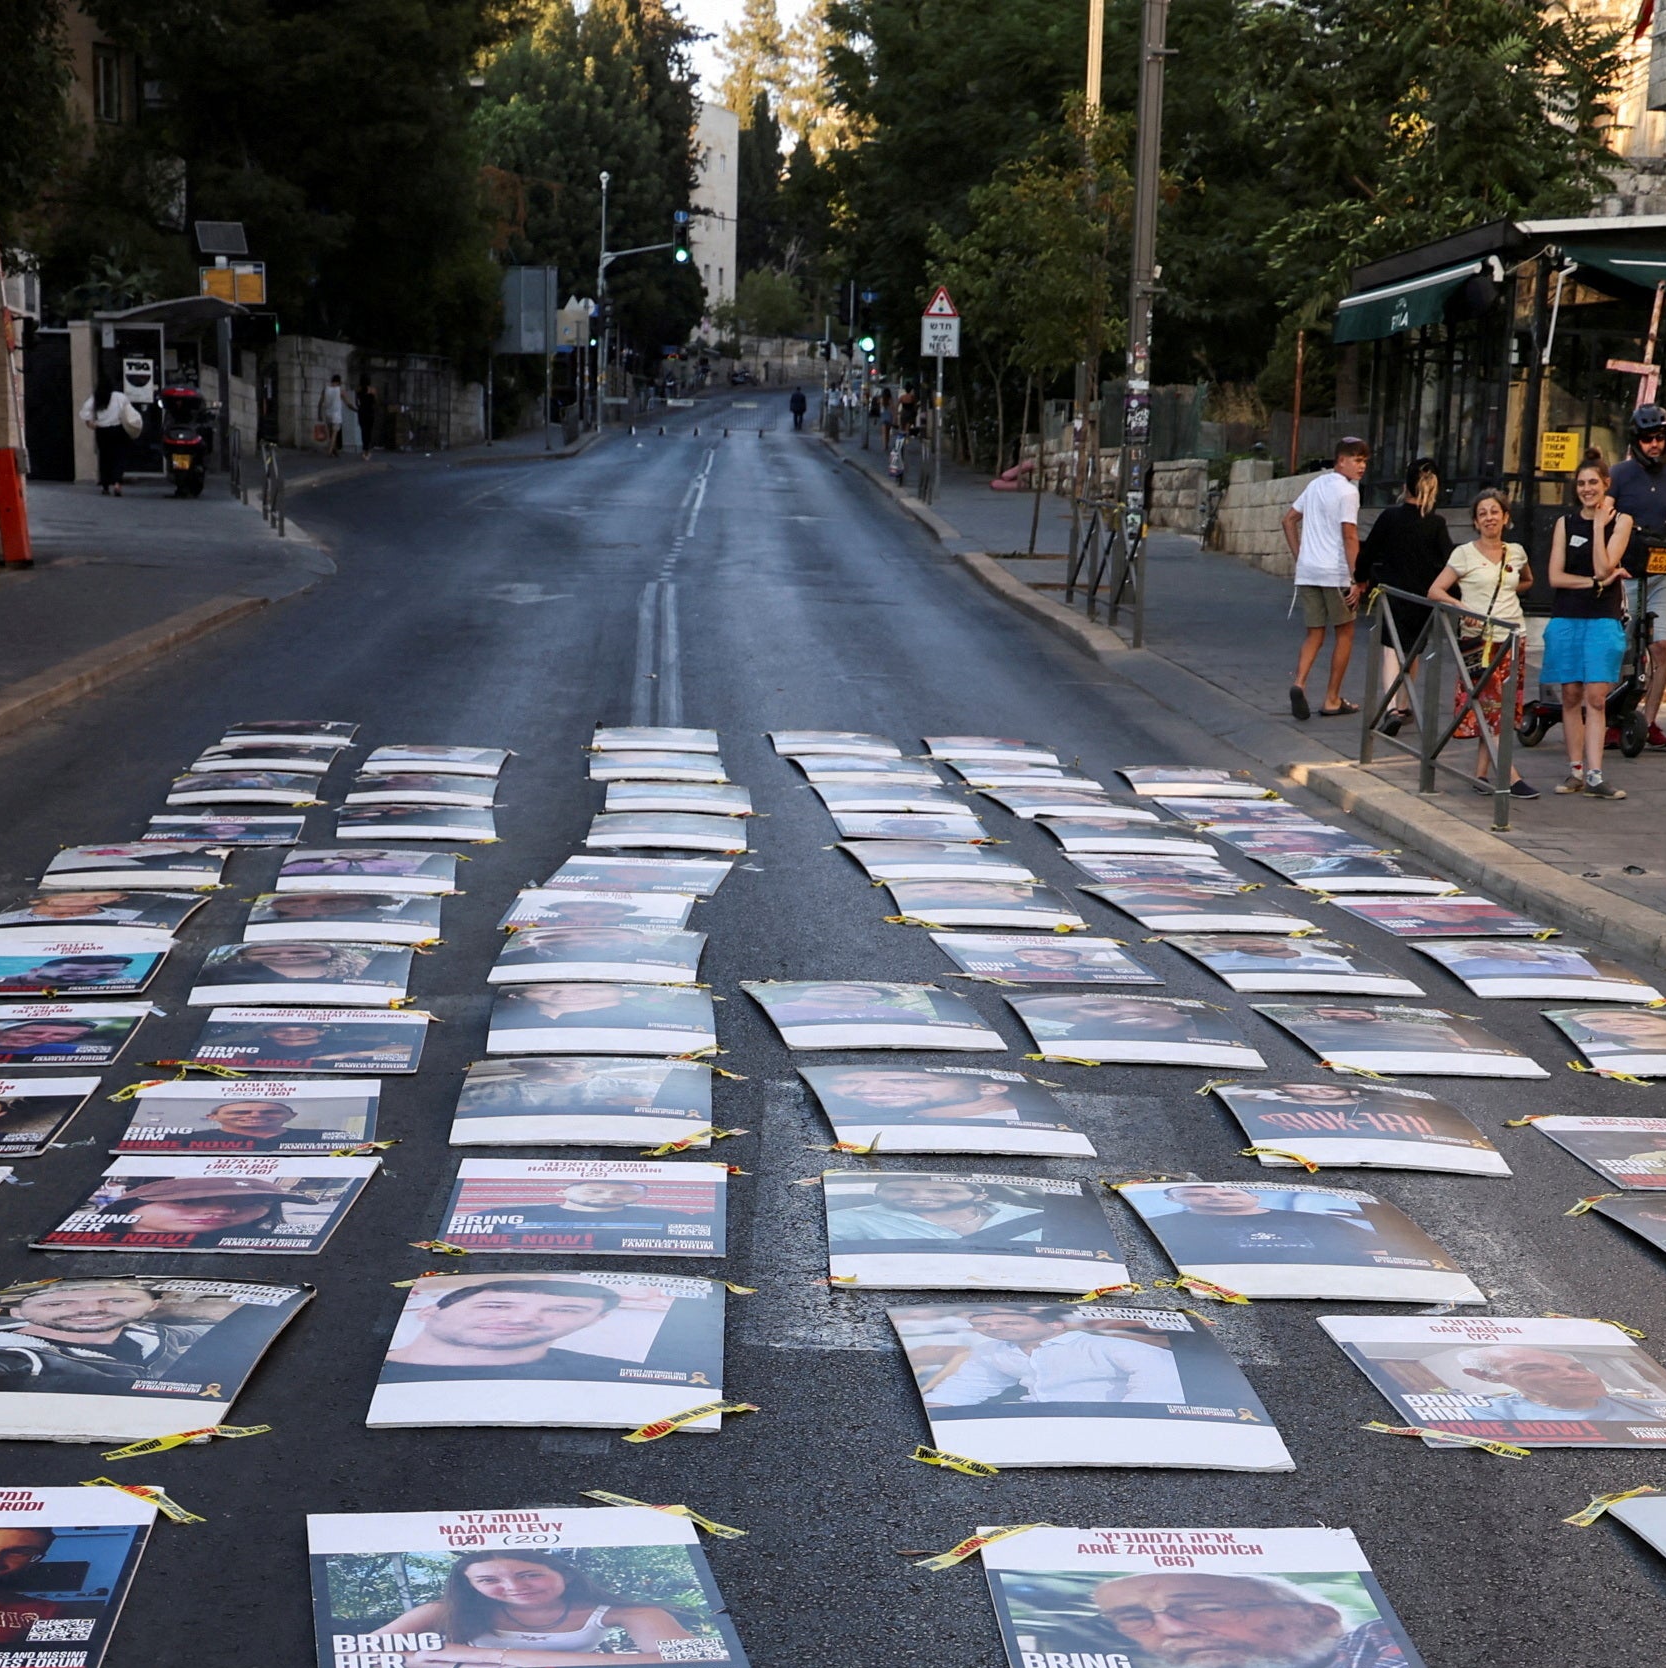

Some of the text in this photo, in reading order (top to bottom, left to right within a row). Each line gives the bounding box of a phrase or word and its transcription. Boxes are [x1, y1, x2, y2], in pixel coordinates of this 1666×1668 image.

[1544, 443, 1566, 451] THEM
[127, 1126, 196, 1134] BRING
[122, 1133, 167, 1141] HIM
[63, 1213, 142, 1224] BRING
[450, 1214, 524, 1225] BRING
[54, 1222, 106, 1232] HER
[447, 1224, 495, 1234] HIM
[444, 1233, 595, 1244] HOME NOW!
[1400, 1393, 1491, 1408] BRING
[1413, 1407, 1475, 1421] HIM
[1515, 1421, 1601, 1437] NOW!
[490, 1512, 540, 1524] נעמה
[439, 1522, 564, 1536] NAAMA LEVY
[502, 1533, 561, 1546] (20)
[1077, 1543, 1264, 1556] ARIE ZALMANOVICH
[1153, 1555, 1195, 1569] (86)
[333, 1632, 445, 1654] BRING
[12, 1651, 36, 1660] AND
[36, 1650, 89, 1660] MISSING
[24, 1657, 87, 1668] FORUM
